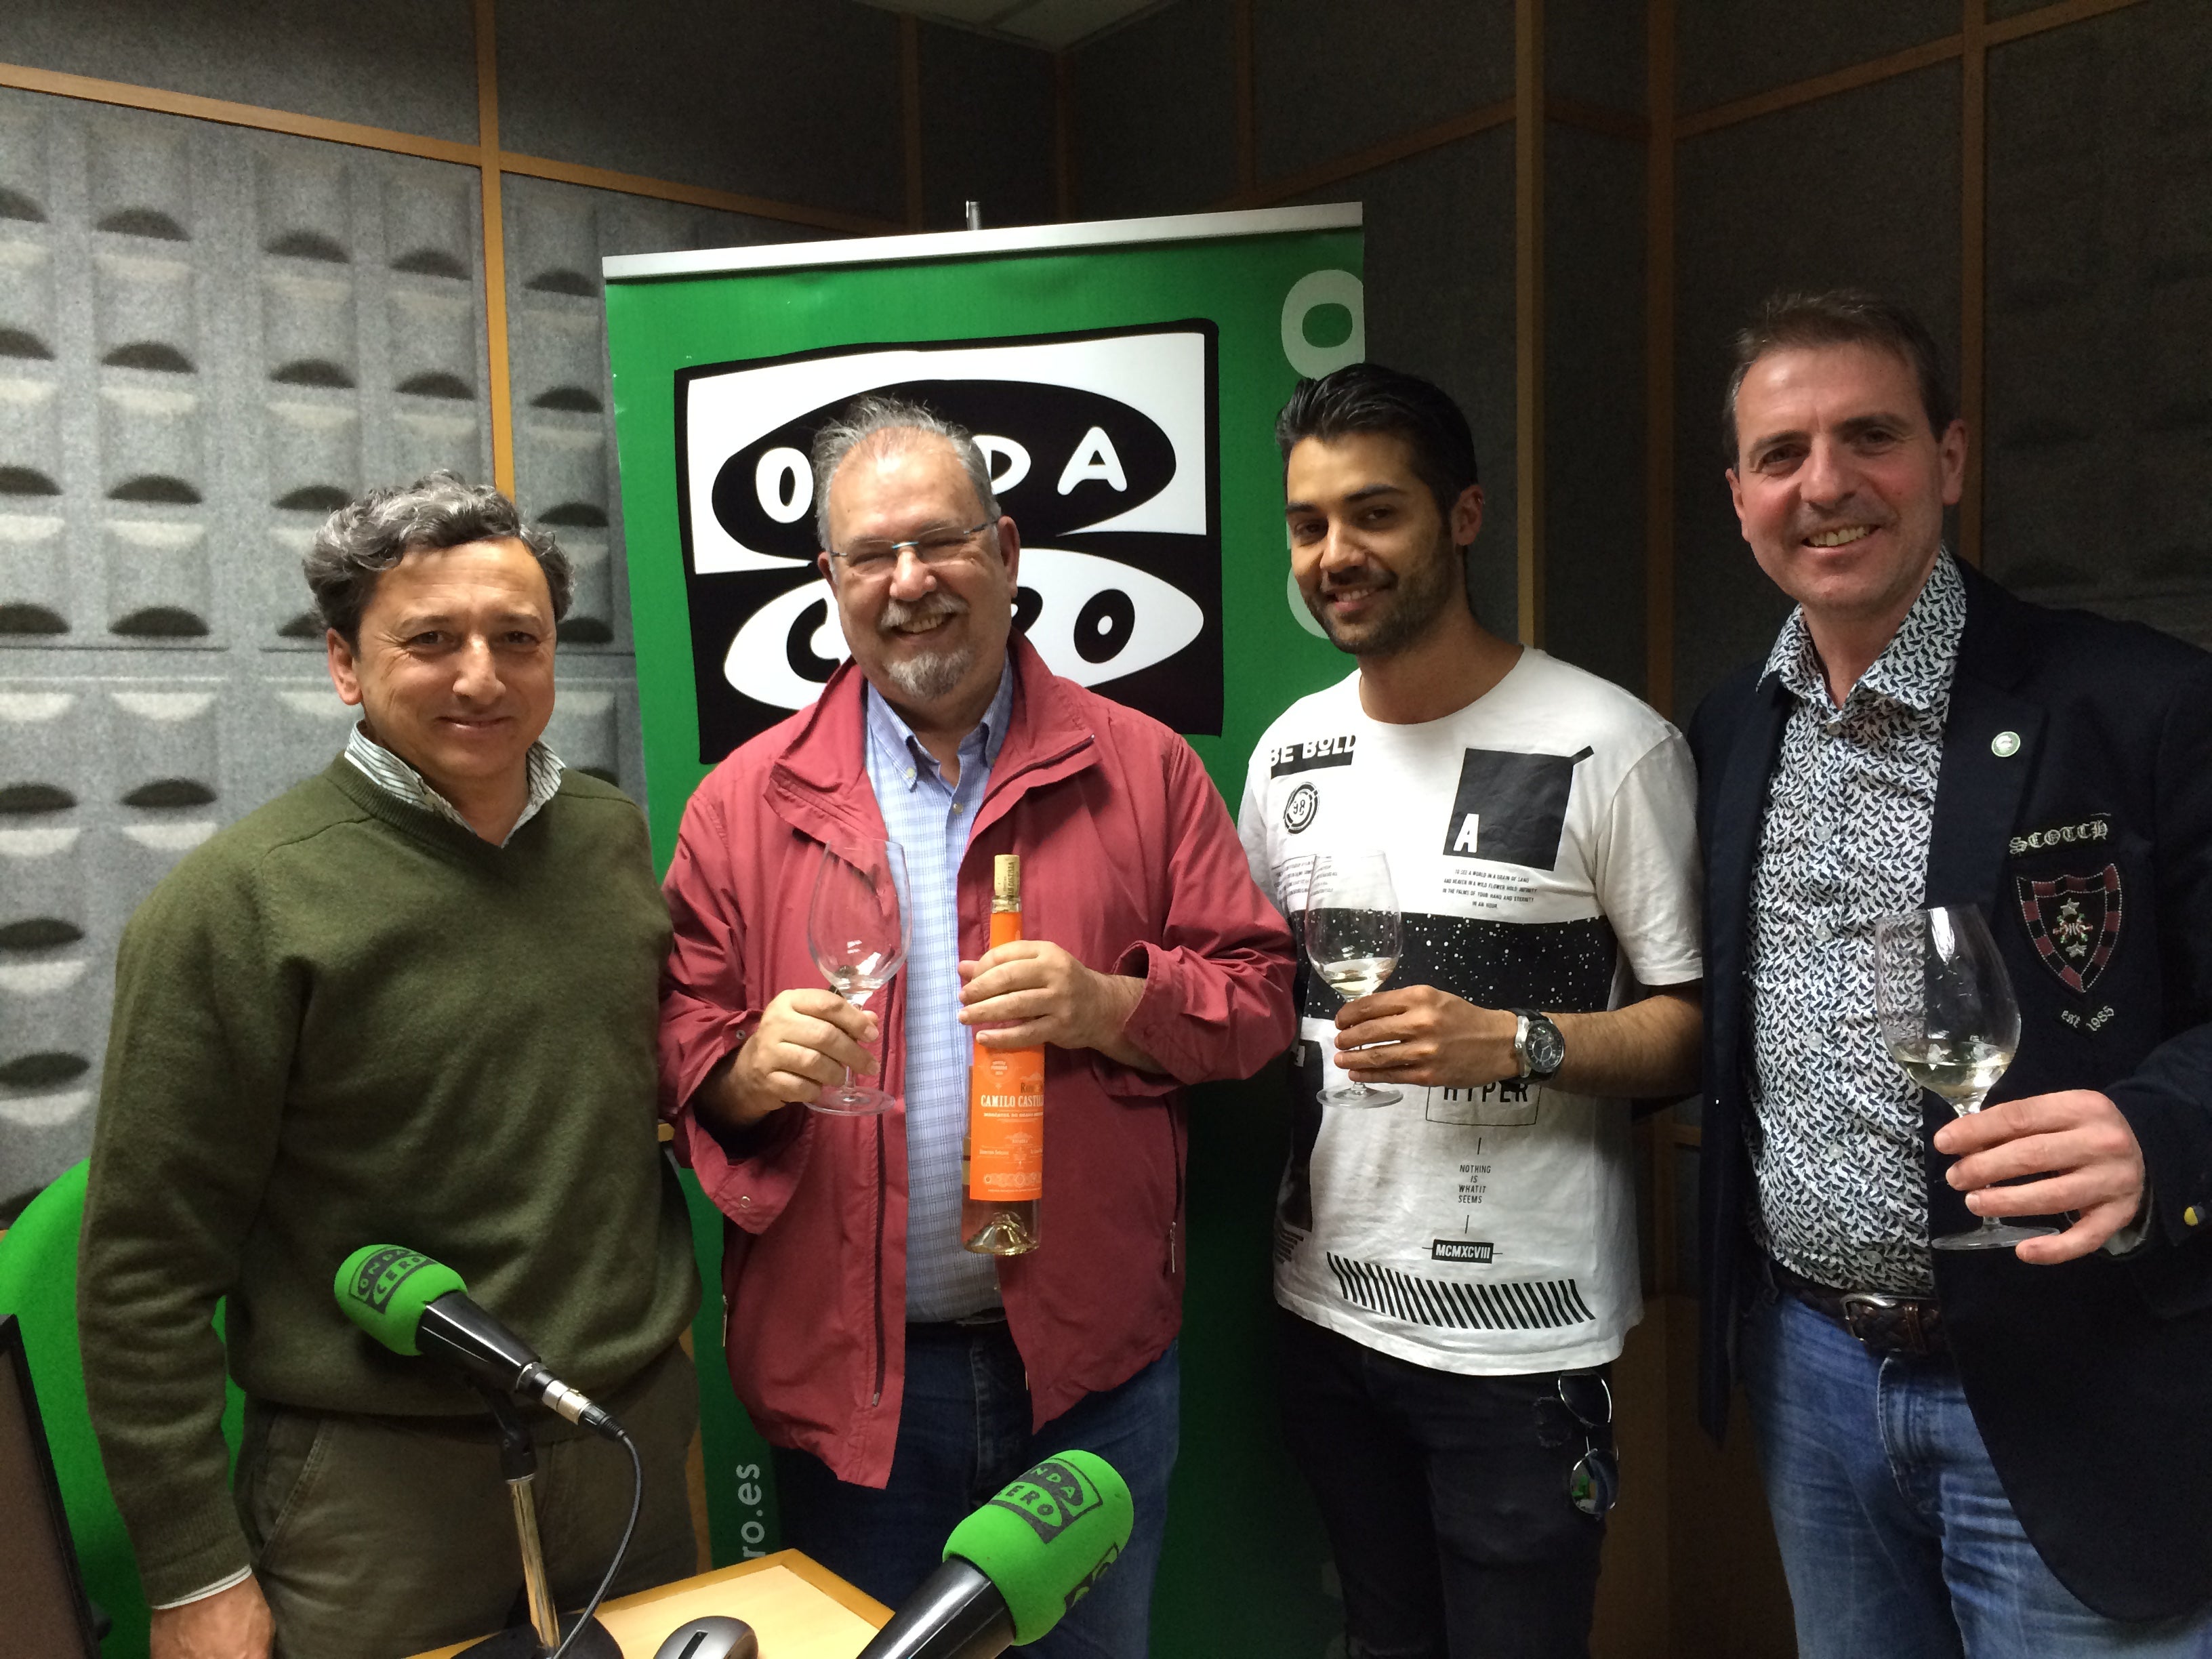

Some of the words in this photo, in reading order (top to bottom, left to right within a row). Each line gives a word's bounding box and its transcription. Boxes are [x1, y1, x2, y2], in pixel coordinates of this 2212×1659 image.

[756, 426, 1128, 524] ODA
[786, 587, 1136, 683] CO
[1271, 747, 1294, 766] BE
[1302, 734, 1356, 759] BOLD
[1453, 813, 1479, 853] A
[2009, 819, 2108, 857] SCOTCH
[981, 1094, 1015, 1107] CAMILO
[1460, 1164, 1491, 1174] NOTHING
[1471, 1175, 1478, 1183] IS
[1458, 1195, 1482, 1204] SEEMS
[1435, 1244, 1490, 1259] MCMXCVIII
[1029, 1467, 1076, 1499] NDA
[1003, 1485, 1054, 1516] ERO
